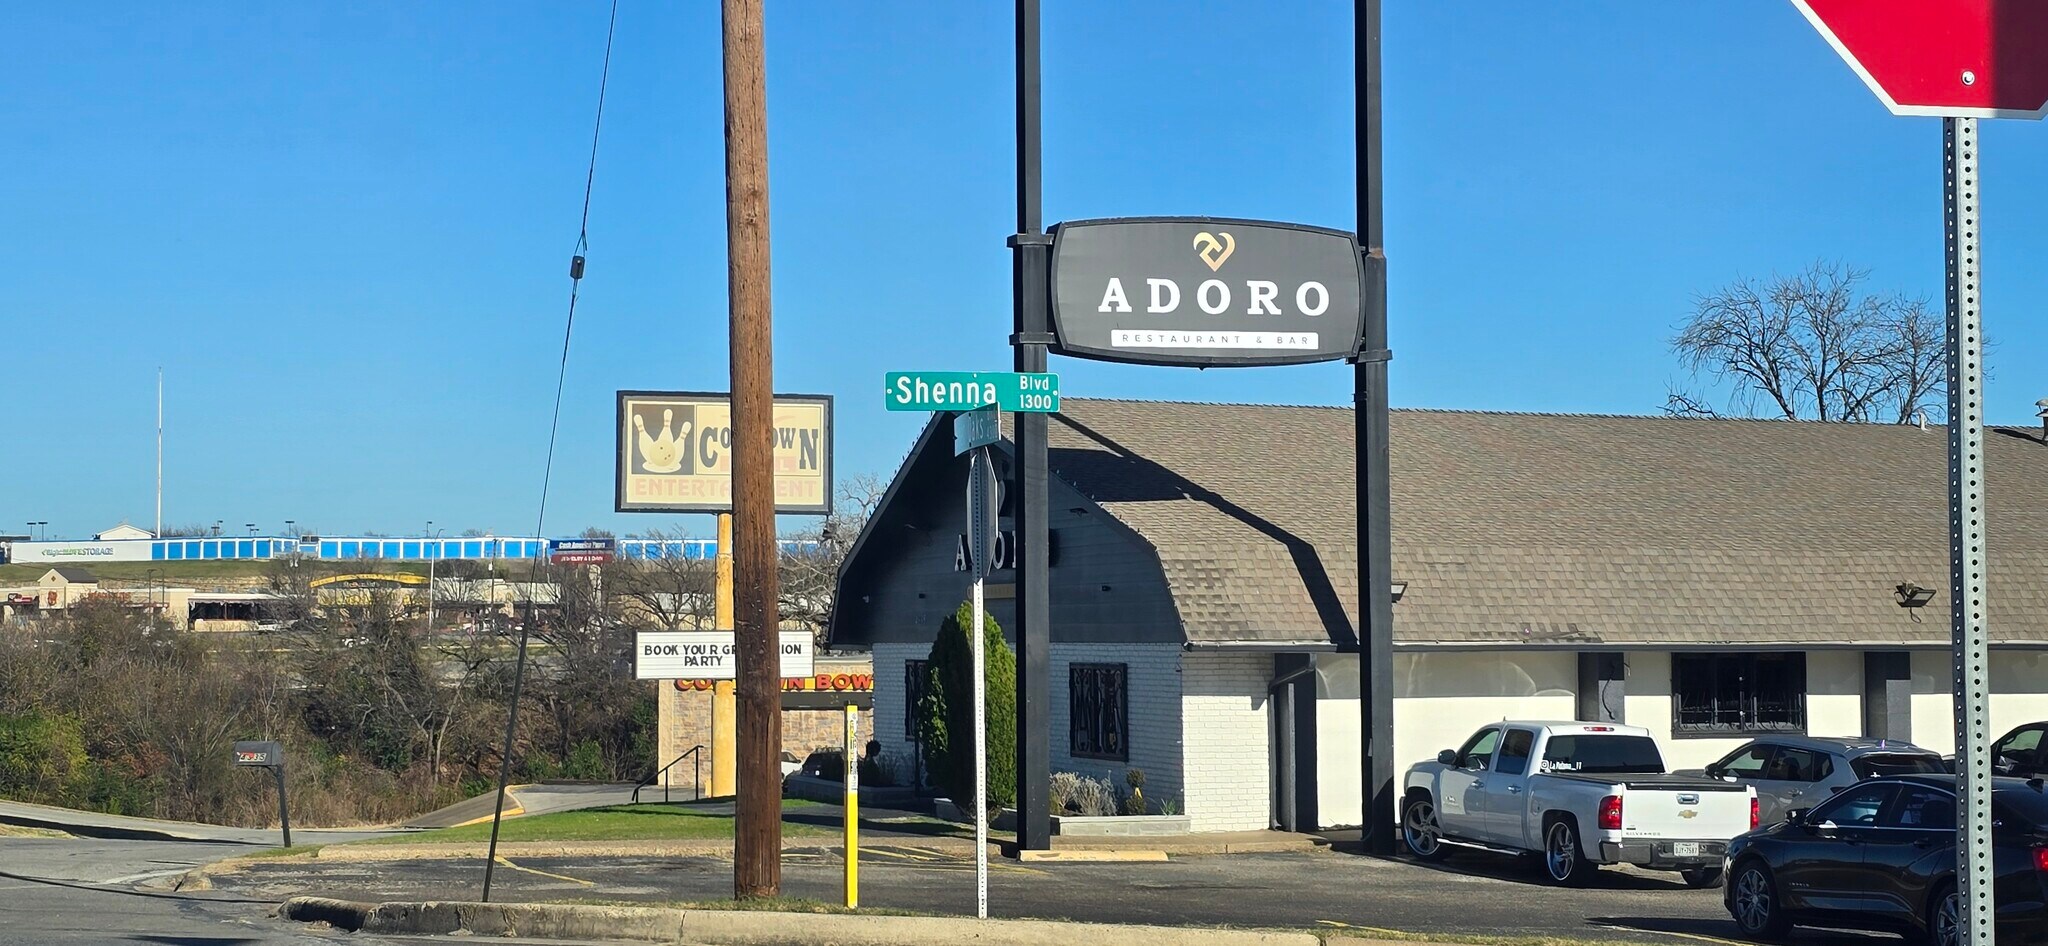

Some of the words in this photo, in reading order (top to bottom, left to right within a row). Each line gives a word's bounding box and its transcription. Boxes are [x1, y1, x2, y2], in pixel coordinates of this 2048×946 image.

[1097, 277, 1330, 317] ADORO
[1122, 333, 1240, 344] RESTAURANT
[1255, 335, 1262, 344] &
[1277, 336, 1308, 345] BAR
[896, 375, 996, 404] Shenna
[1019, 375, 1049, 391] Blvd
[1019, 394, 1052, 409] 1300
[634, 478, 817, 498] ENTERTAENT
[644, 644, 679, 655] BOOK
[684, 655, 723, 666] PARTY
